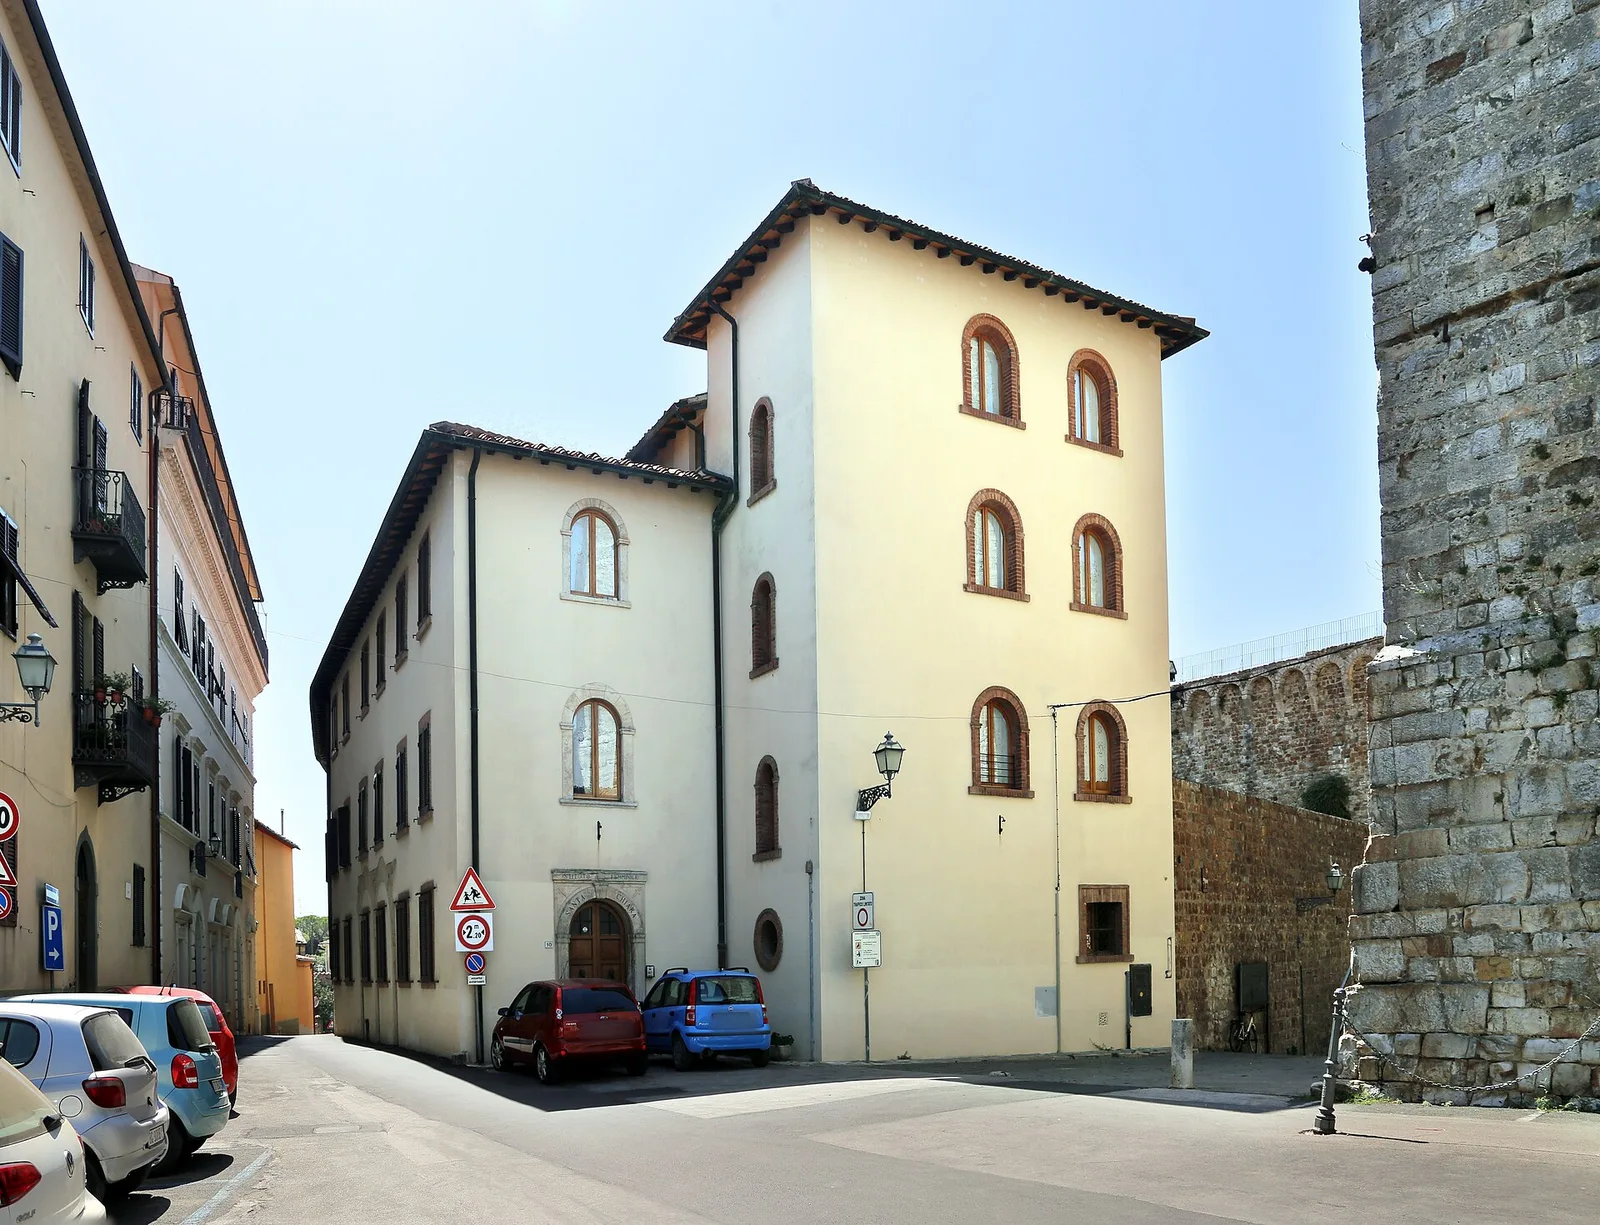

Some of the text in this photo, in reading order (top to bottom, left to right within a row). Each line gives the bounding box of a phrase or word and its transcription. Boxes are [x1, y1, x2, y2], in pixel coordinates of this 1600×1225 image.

[0, 806, 10, 828] 0
[565, 893, 637, 919] SANTA CHIARA
[48, 911, 58, 940] P
[16, 1209, 36, 1224] GOLF
